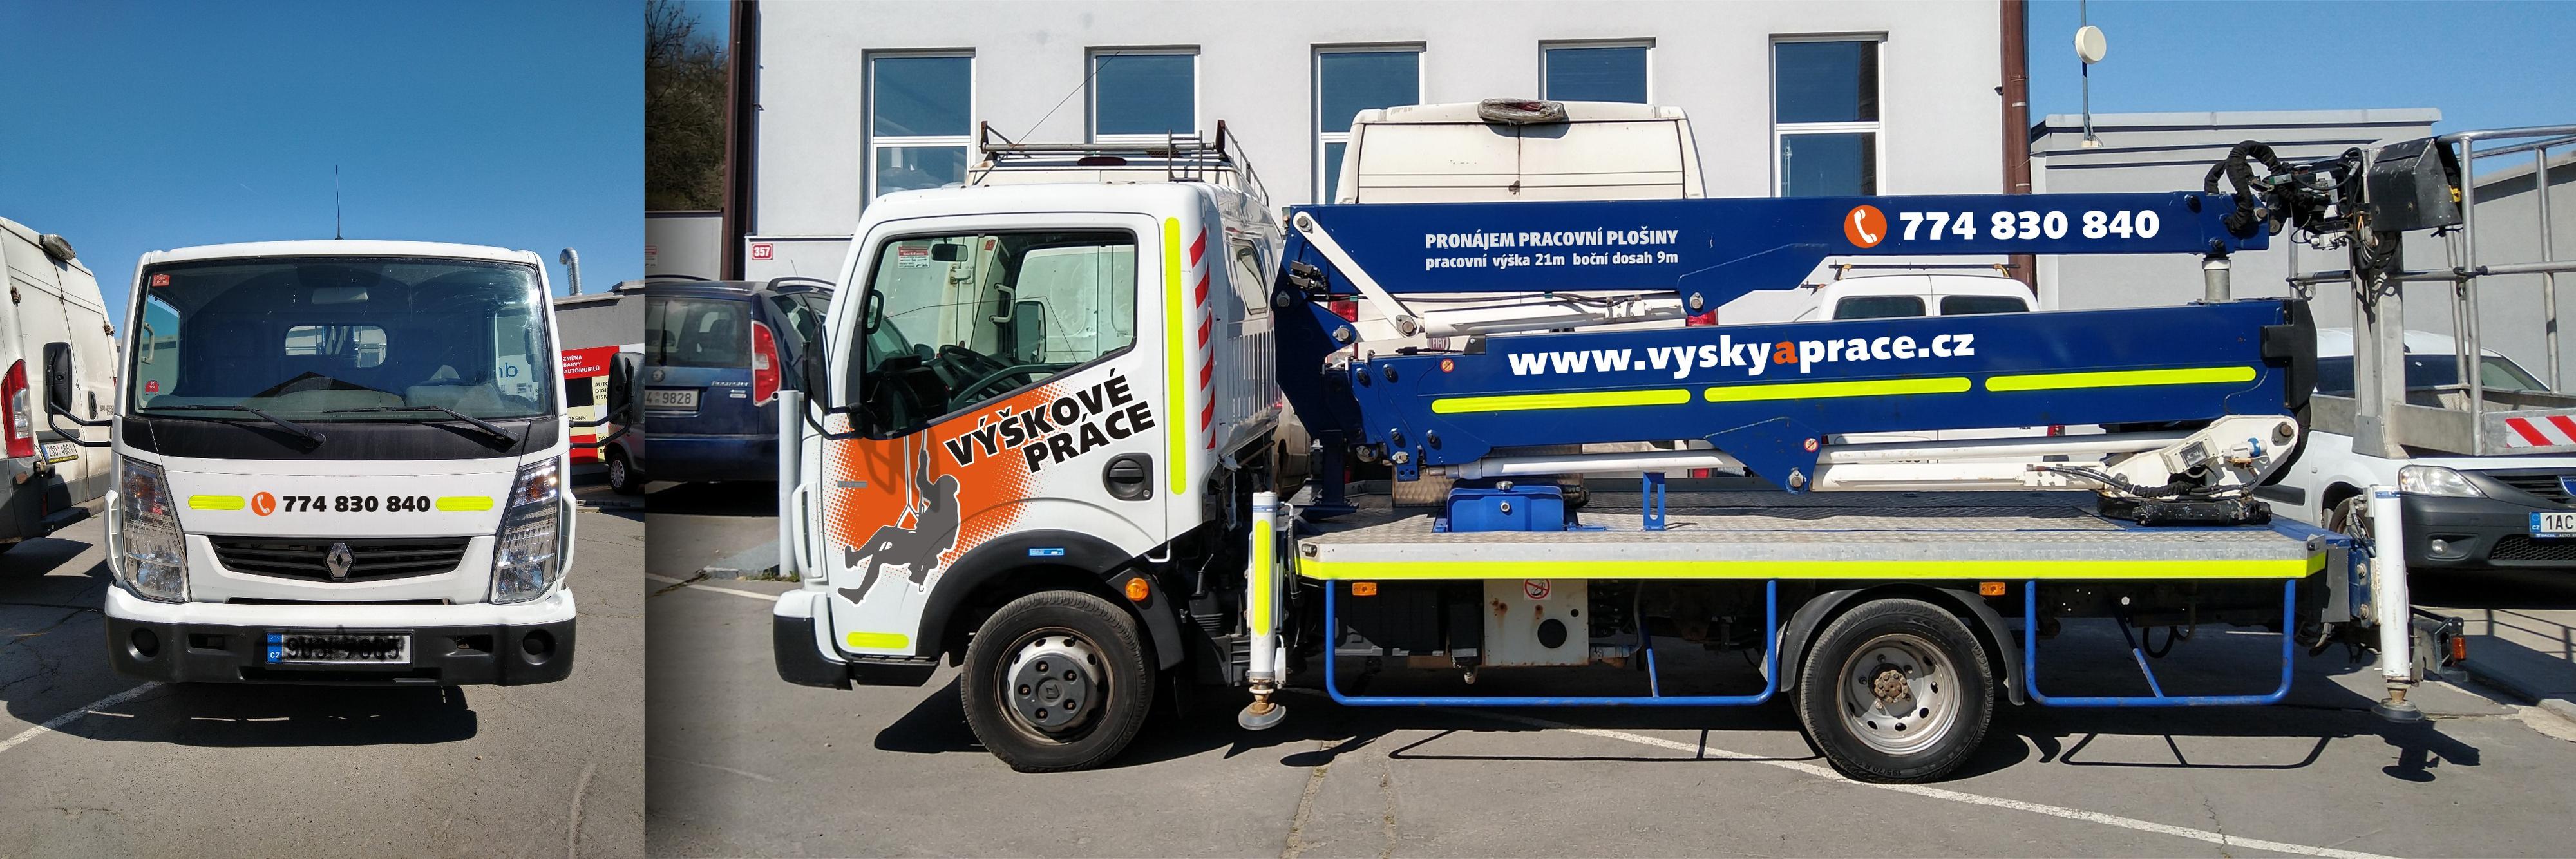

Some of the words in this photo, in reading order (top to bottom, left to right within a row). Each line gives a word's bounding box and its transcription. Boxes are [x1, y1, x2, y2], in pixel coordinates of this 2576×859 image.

[1900, 211, 1976, 240] 774
[1991, 211, 2069, 240] 830
[2082, 209, 2160, 239] 840
[1425, 229, 1515, 250] PRONÁJEM
[1519, 227, 1603, 247] PRACOVNÍ
[1607, 225, 1679, 245] PLOŠINY
[753, 247, 770, 257] 357
[1426, 254, 1487, 271] pracovní
[1492, 254, 1531, 269] výška
[1535, 253, 1565, 266] 21m
[1573, 252, 1608, 265] boční
[1612, 251, 1653, 265] dosah
[1657, 251, 1678, 263] 9m
[1432, 338, 1446, 348] FIAT
[1508, 334, 1975, 379] www.vyskyaprace.cz
[564, 365, 600, 373] AUTOMOBILŮ
[662, 392, 692, 404] 9828
[945, 368, 1133, 466] VÝŠKOVÉ
[1023, 401, 1156, 473] PRÁCE
[283, 496, 327, 513] 774
[334, 496, 379, 513] 830
[386, 496, 431, 513] 840
[2546, 514, 2574, 530] 1AC
